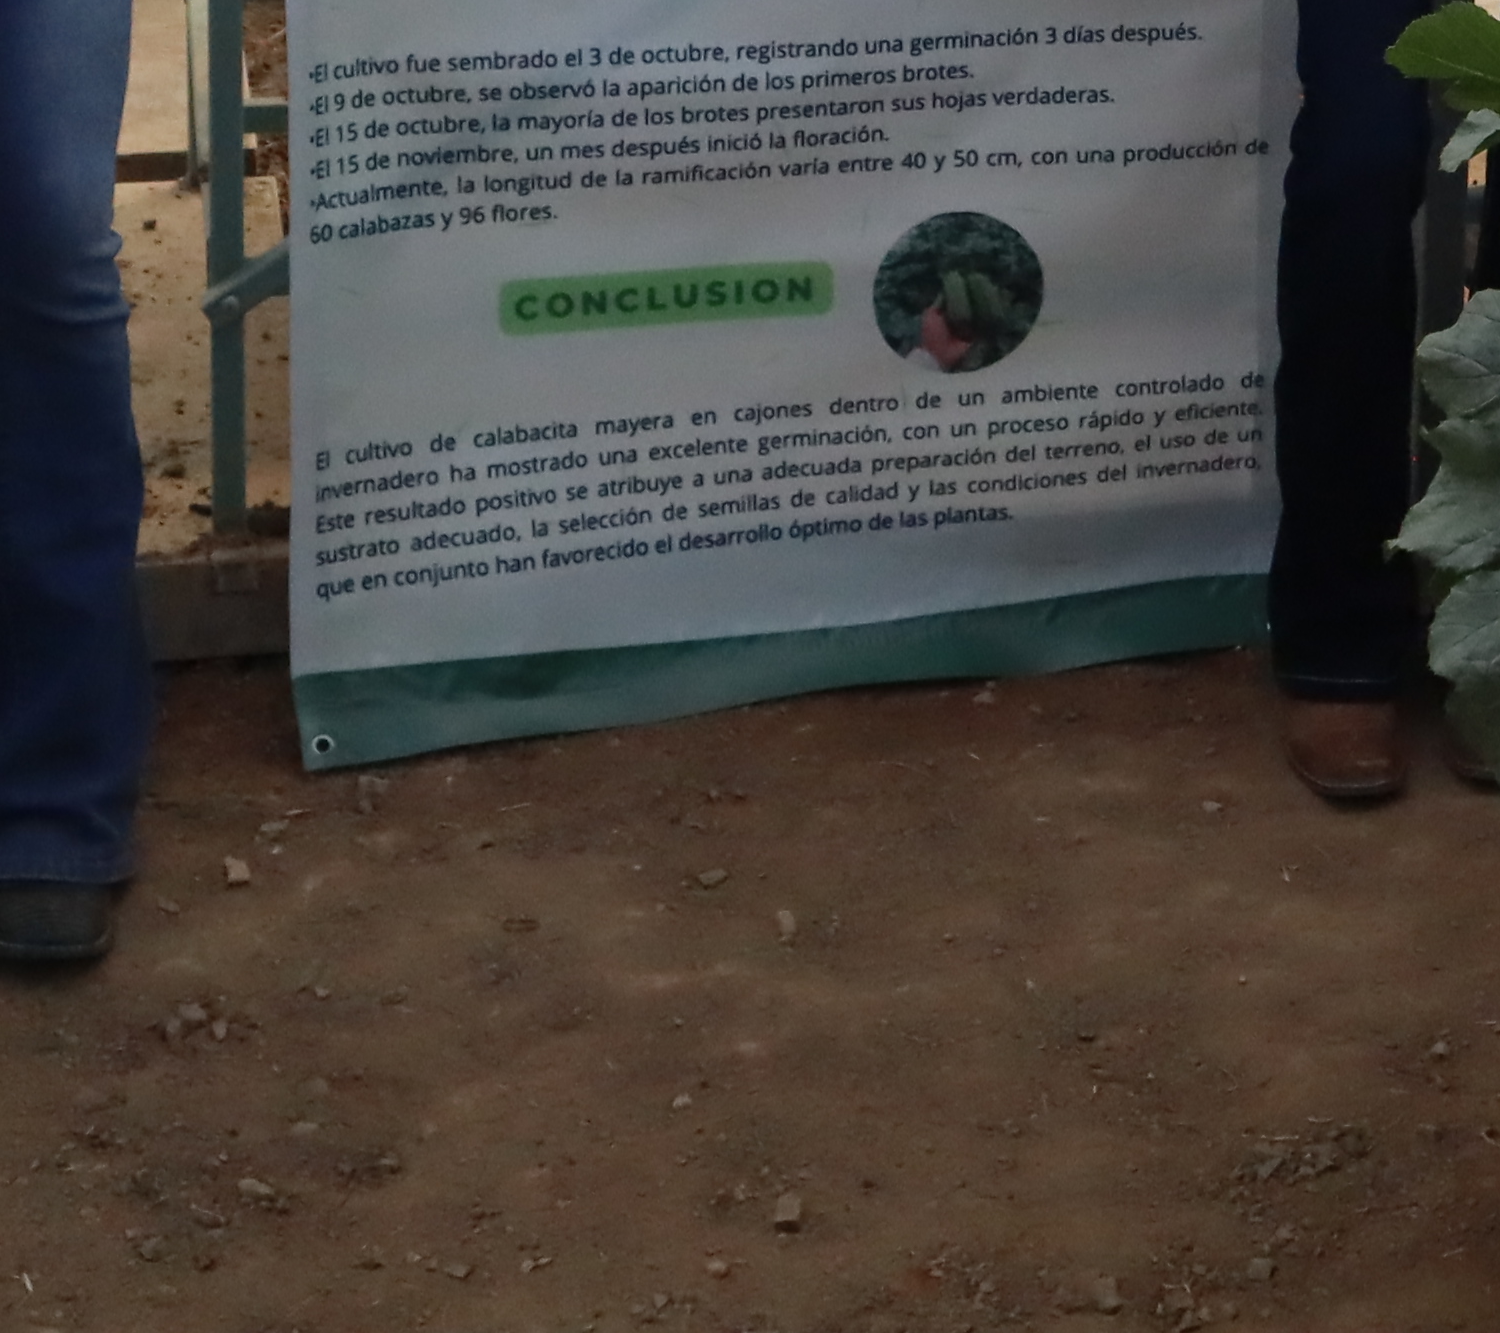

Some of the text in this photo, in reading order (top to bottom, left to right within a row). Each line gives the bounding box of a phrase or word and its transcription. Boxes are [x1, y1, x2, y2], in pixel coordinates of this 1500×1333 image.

[334, 93, 345, 111] 9
[351, 89, 376, 109] de
[382, 86, 471, 105] octubre,
[479, 87, 502, 101] se
[509, 79, 595, 100] observó
[603, 79, 620, 97] la
[627, 75, 726, 100] aparición
[732, 73, 758, 92] de
[766, 72, 794, 90] los
[801, 70, 896, 93] primeros
[903, 65, 974, 82] brotes.
[310, 204, 557, 244] 60 calabazas y 96 flores.
[514, 277, 813, 321] CONCLUSION
[316, 403, 1261, 503] invernadero ha mostrado una excelente germinación, con un proceso rápido y eficiente.
